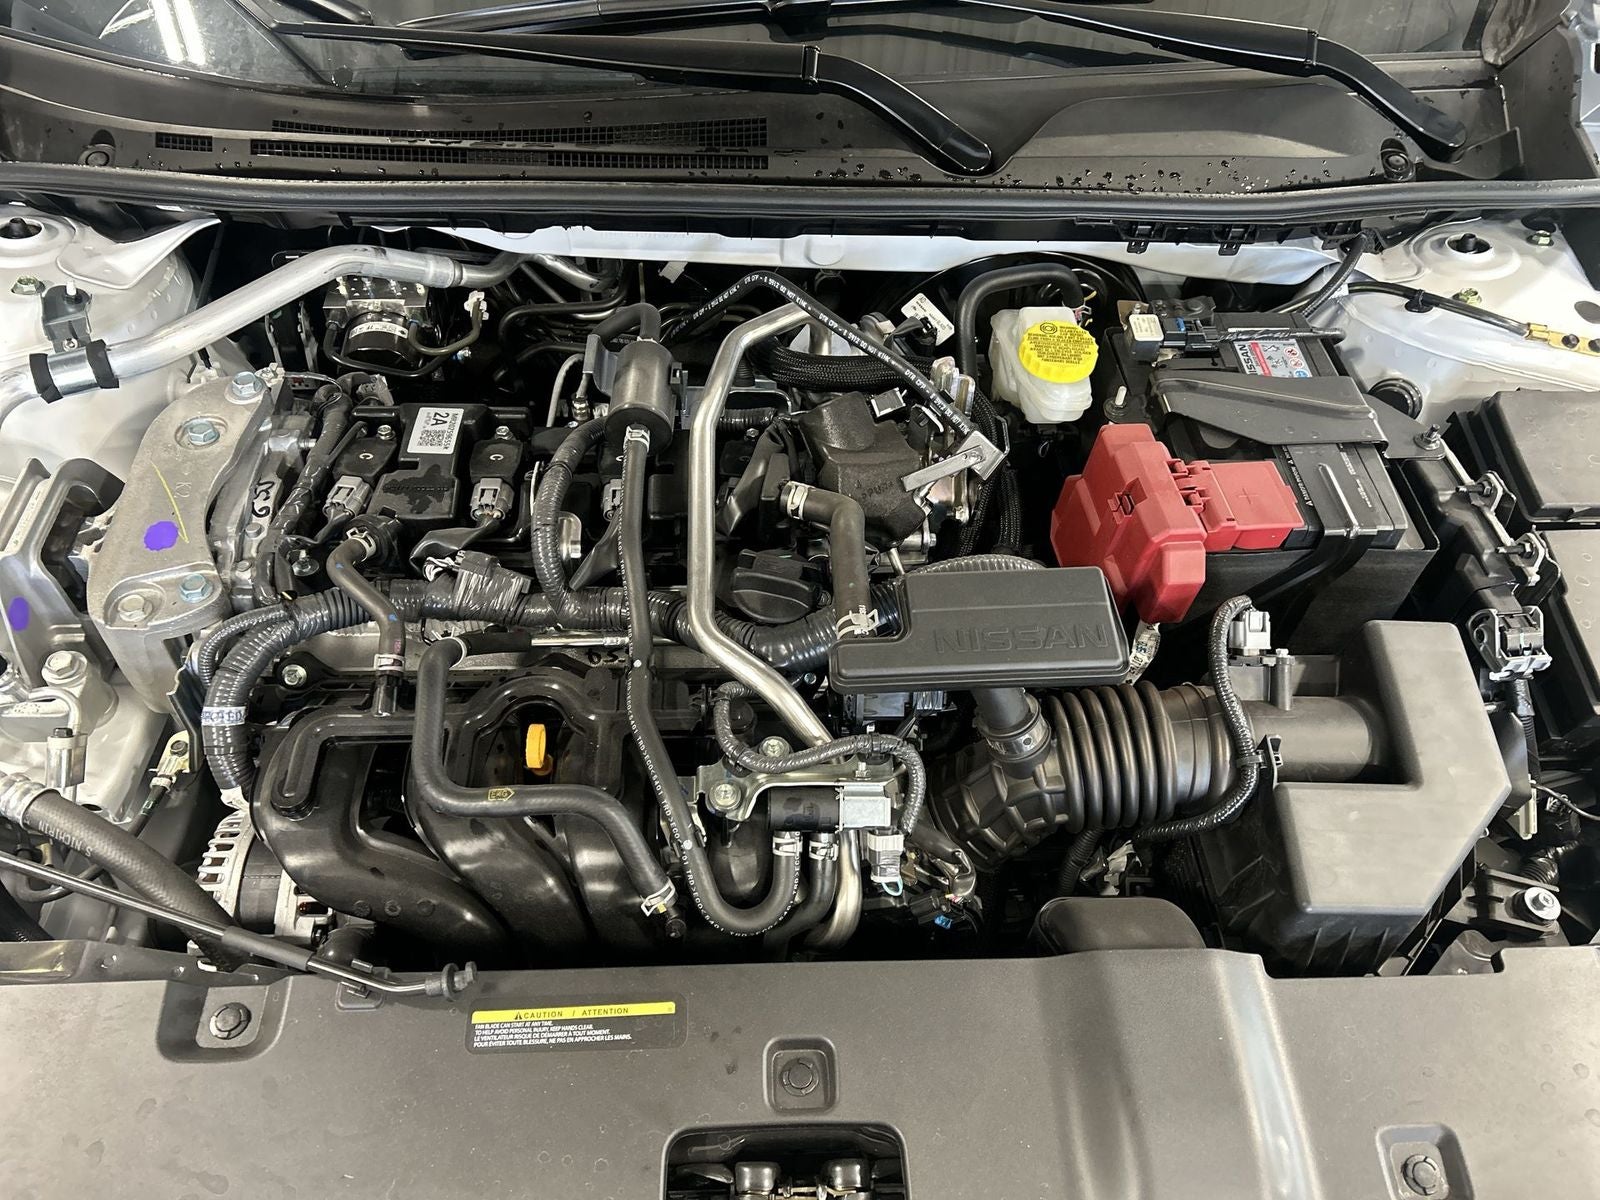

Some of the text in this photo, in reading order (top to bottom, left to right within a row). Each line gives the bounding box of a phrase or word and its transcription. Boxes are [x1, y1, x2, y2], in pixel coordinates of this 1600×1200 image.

[1238, 344, 1256, 372] ISSAN
[431, 412, 449, 426] 2A
[934, 624, 1108, 653] NISSAN
[39, 820, 82, 851] NICHIRIN
[524, 1011, 563, 1019] CAUTION
[582, 1008, 629, 1016] ATTENTION
